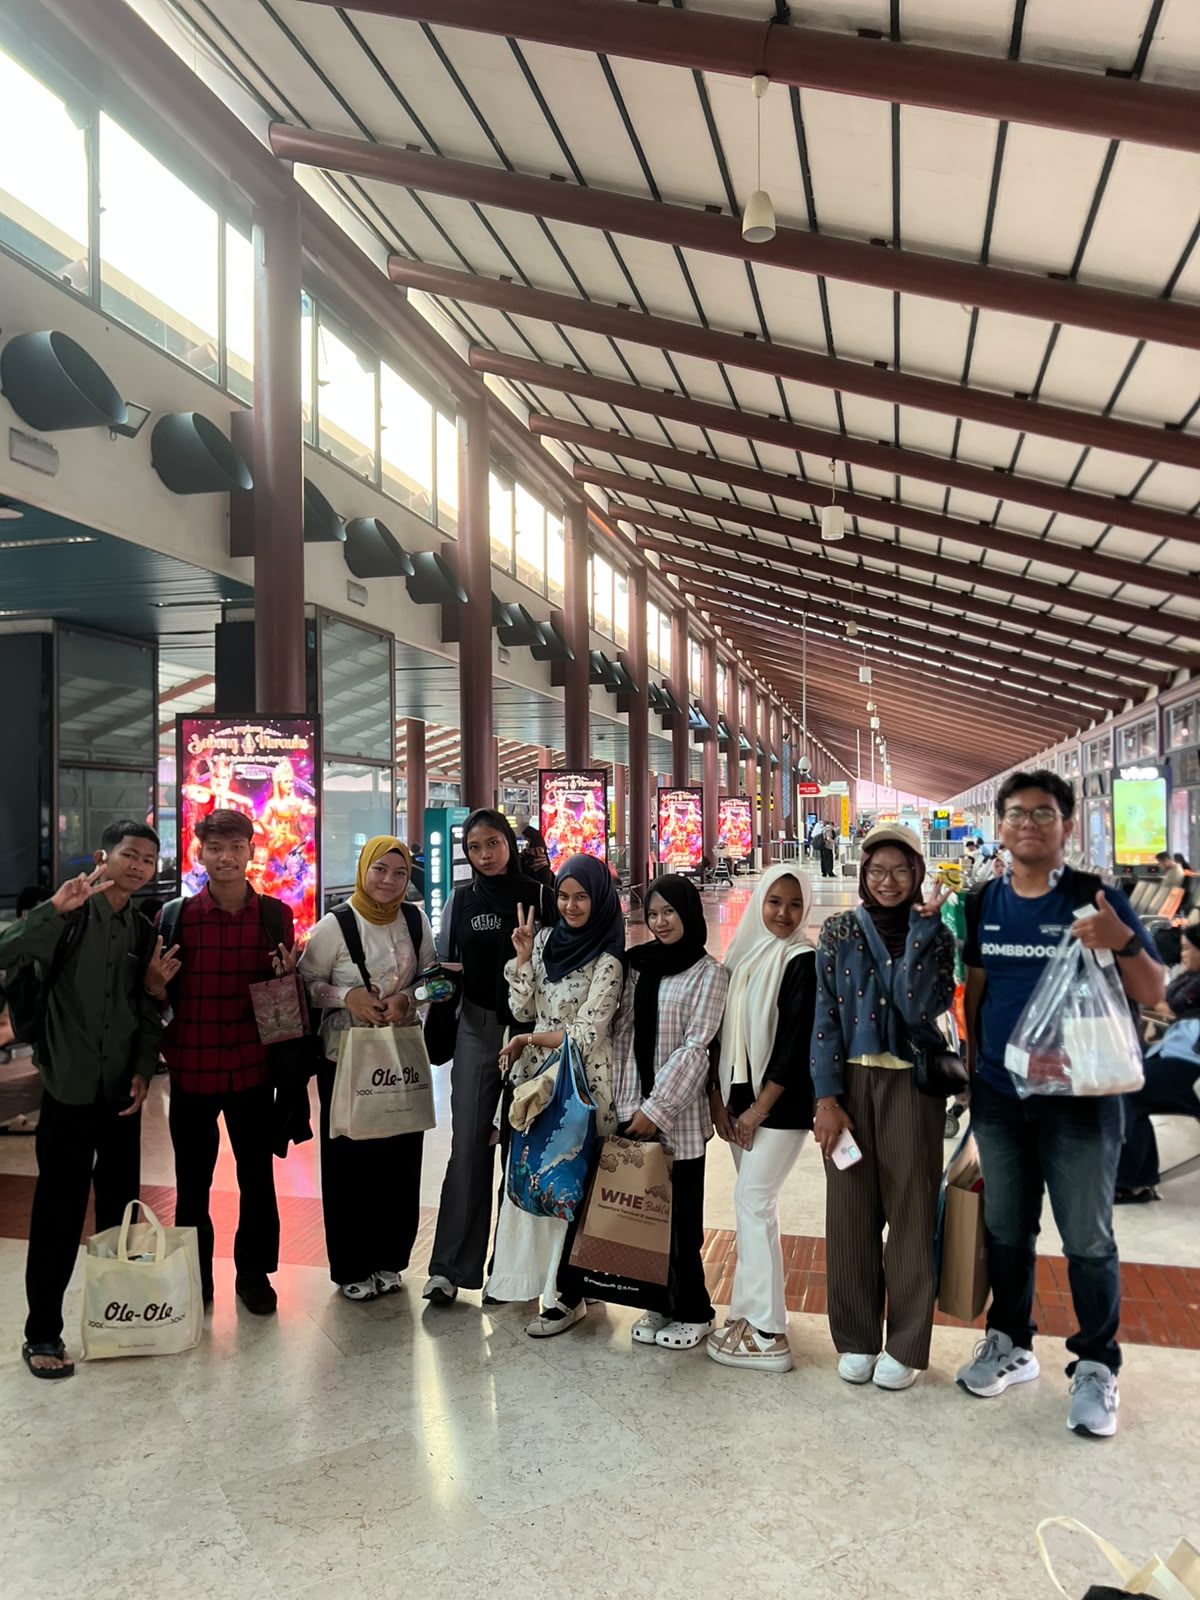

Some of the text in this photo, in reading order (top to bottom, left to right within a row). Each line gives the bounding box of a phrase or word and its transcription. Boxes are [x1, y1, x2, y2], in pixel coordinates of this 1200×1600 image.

[187, 734, 239, 755] Sabang
[431, 847, 441, 884] FREE
[431, 888, 442, 937] CHARG
[981, 943, 1071, 958] BOMBBOOG
[371, 1066, 420, 1087] Ole-Ole
[601, 1187, 645, 1210] WHE
[104, 1301, 173, 1322] Ole-Ole
